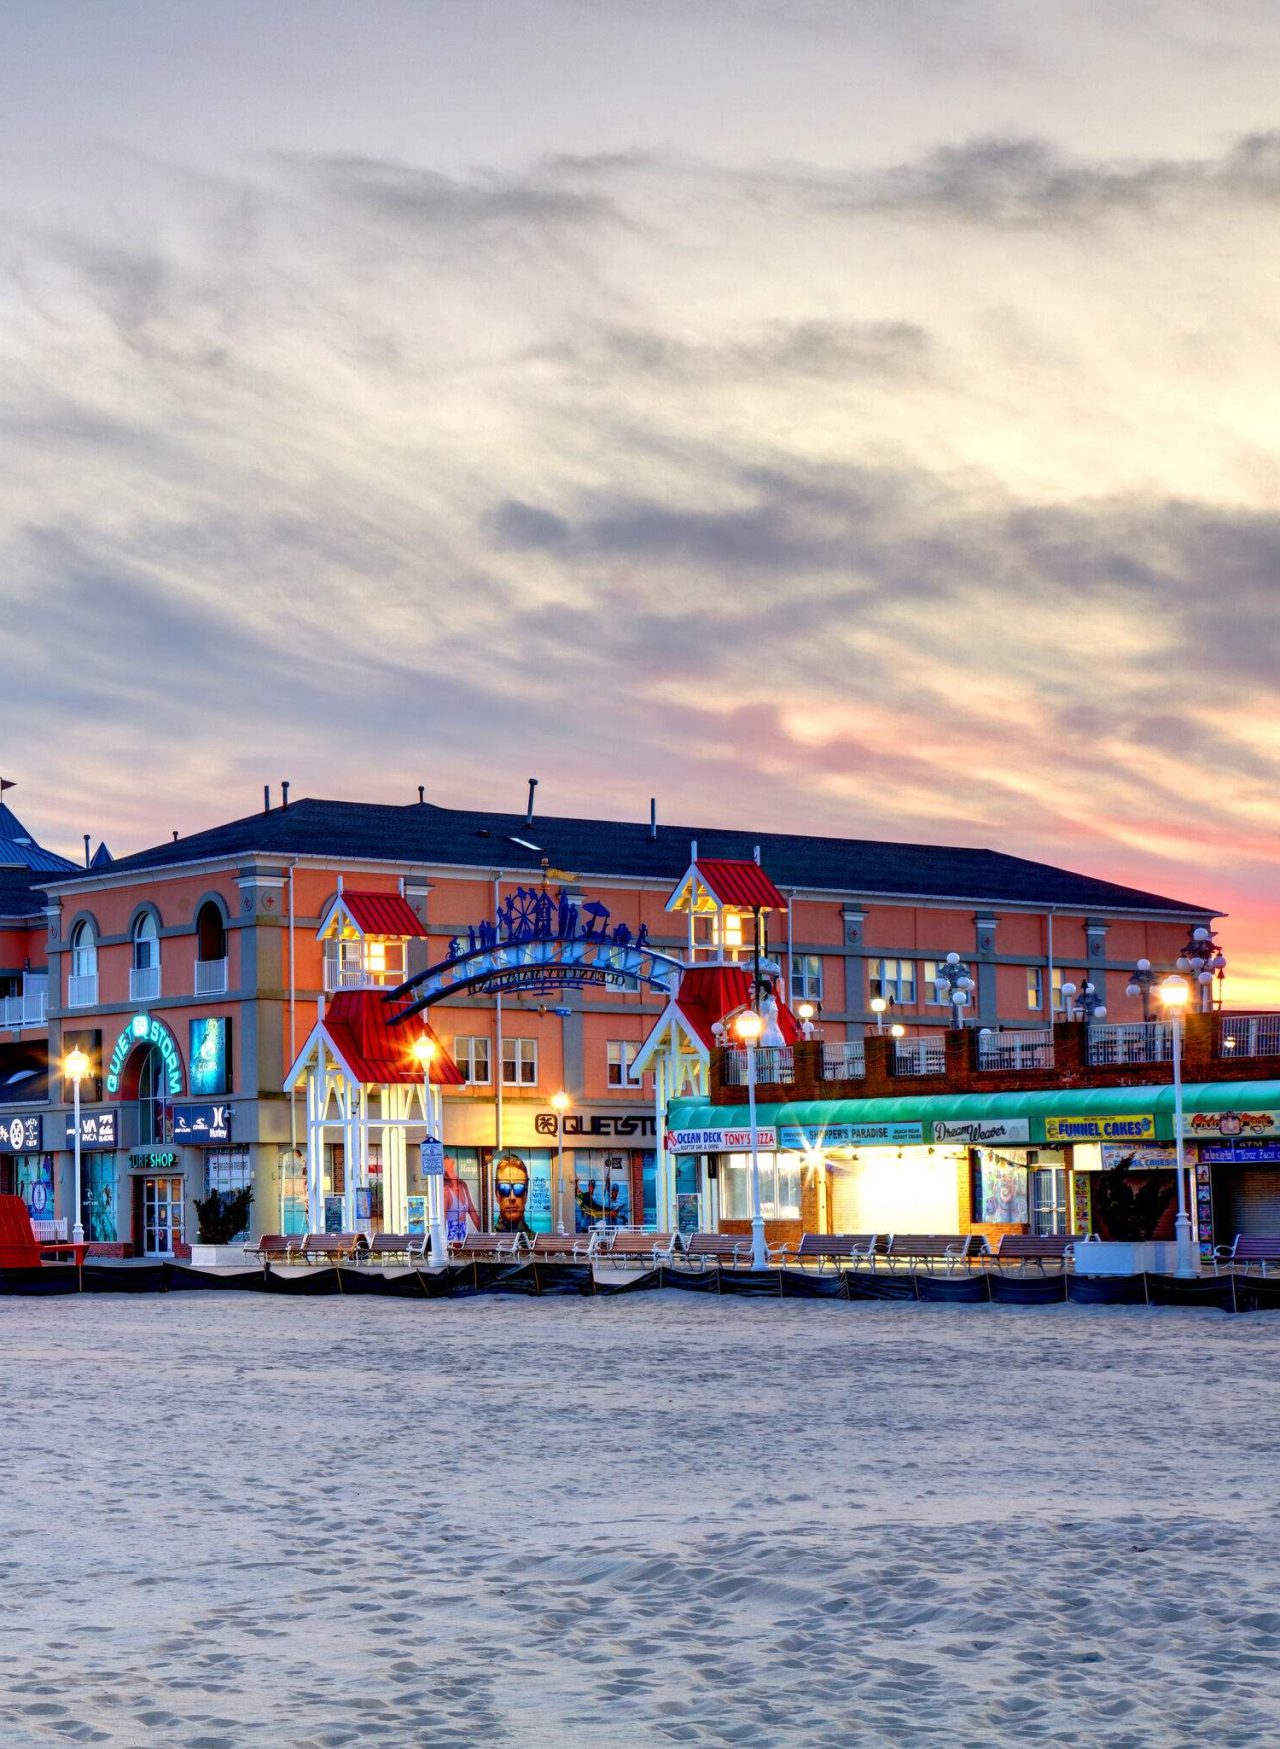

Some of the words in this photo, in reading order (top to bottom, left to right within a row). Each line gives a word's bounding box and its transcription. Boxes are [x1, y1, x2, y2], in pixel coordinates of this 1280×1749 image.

[106, 1023, 136, 1093] QUIET
[150, 1021, 183, 1094] STORM
[209, 1128, 227, 1139] Hurley
[851, 1127, 888, 1139] PARADISE
[934, 1122, 972, 1142] Dream
[969, 1122, 1007, 1142] Weaver
[1058, 1123, 1101, 1137] FUNNEL
[1104, 1121, 1142, 1136] CAKES
[677, 1132, 701, 1144] OCEAN
[703, 1131, 722, 1144] DECK
[724, 1132, 751, 1145] TONY'S
[757, 1131, 775, 1144] IZZA
[128, 1154, 149, 1168] SURF
[150, 1153, 174, 1167] SHOP
